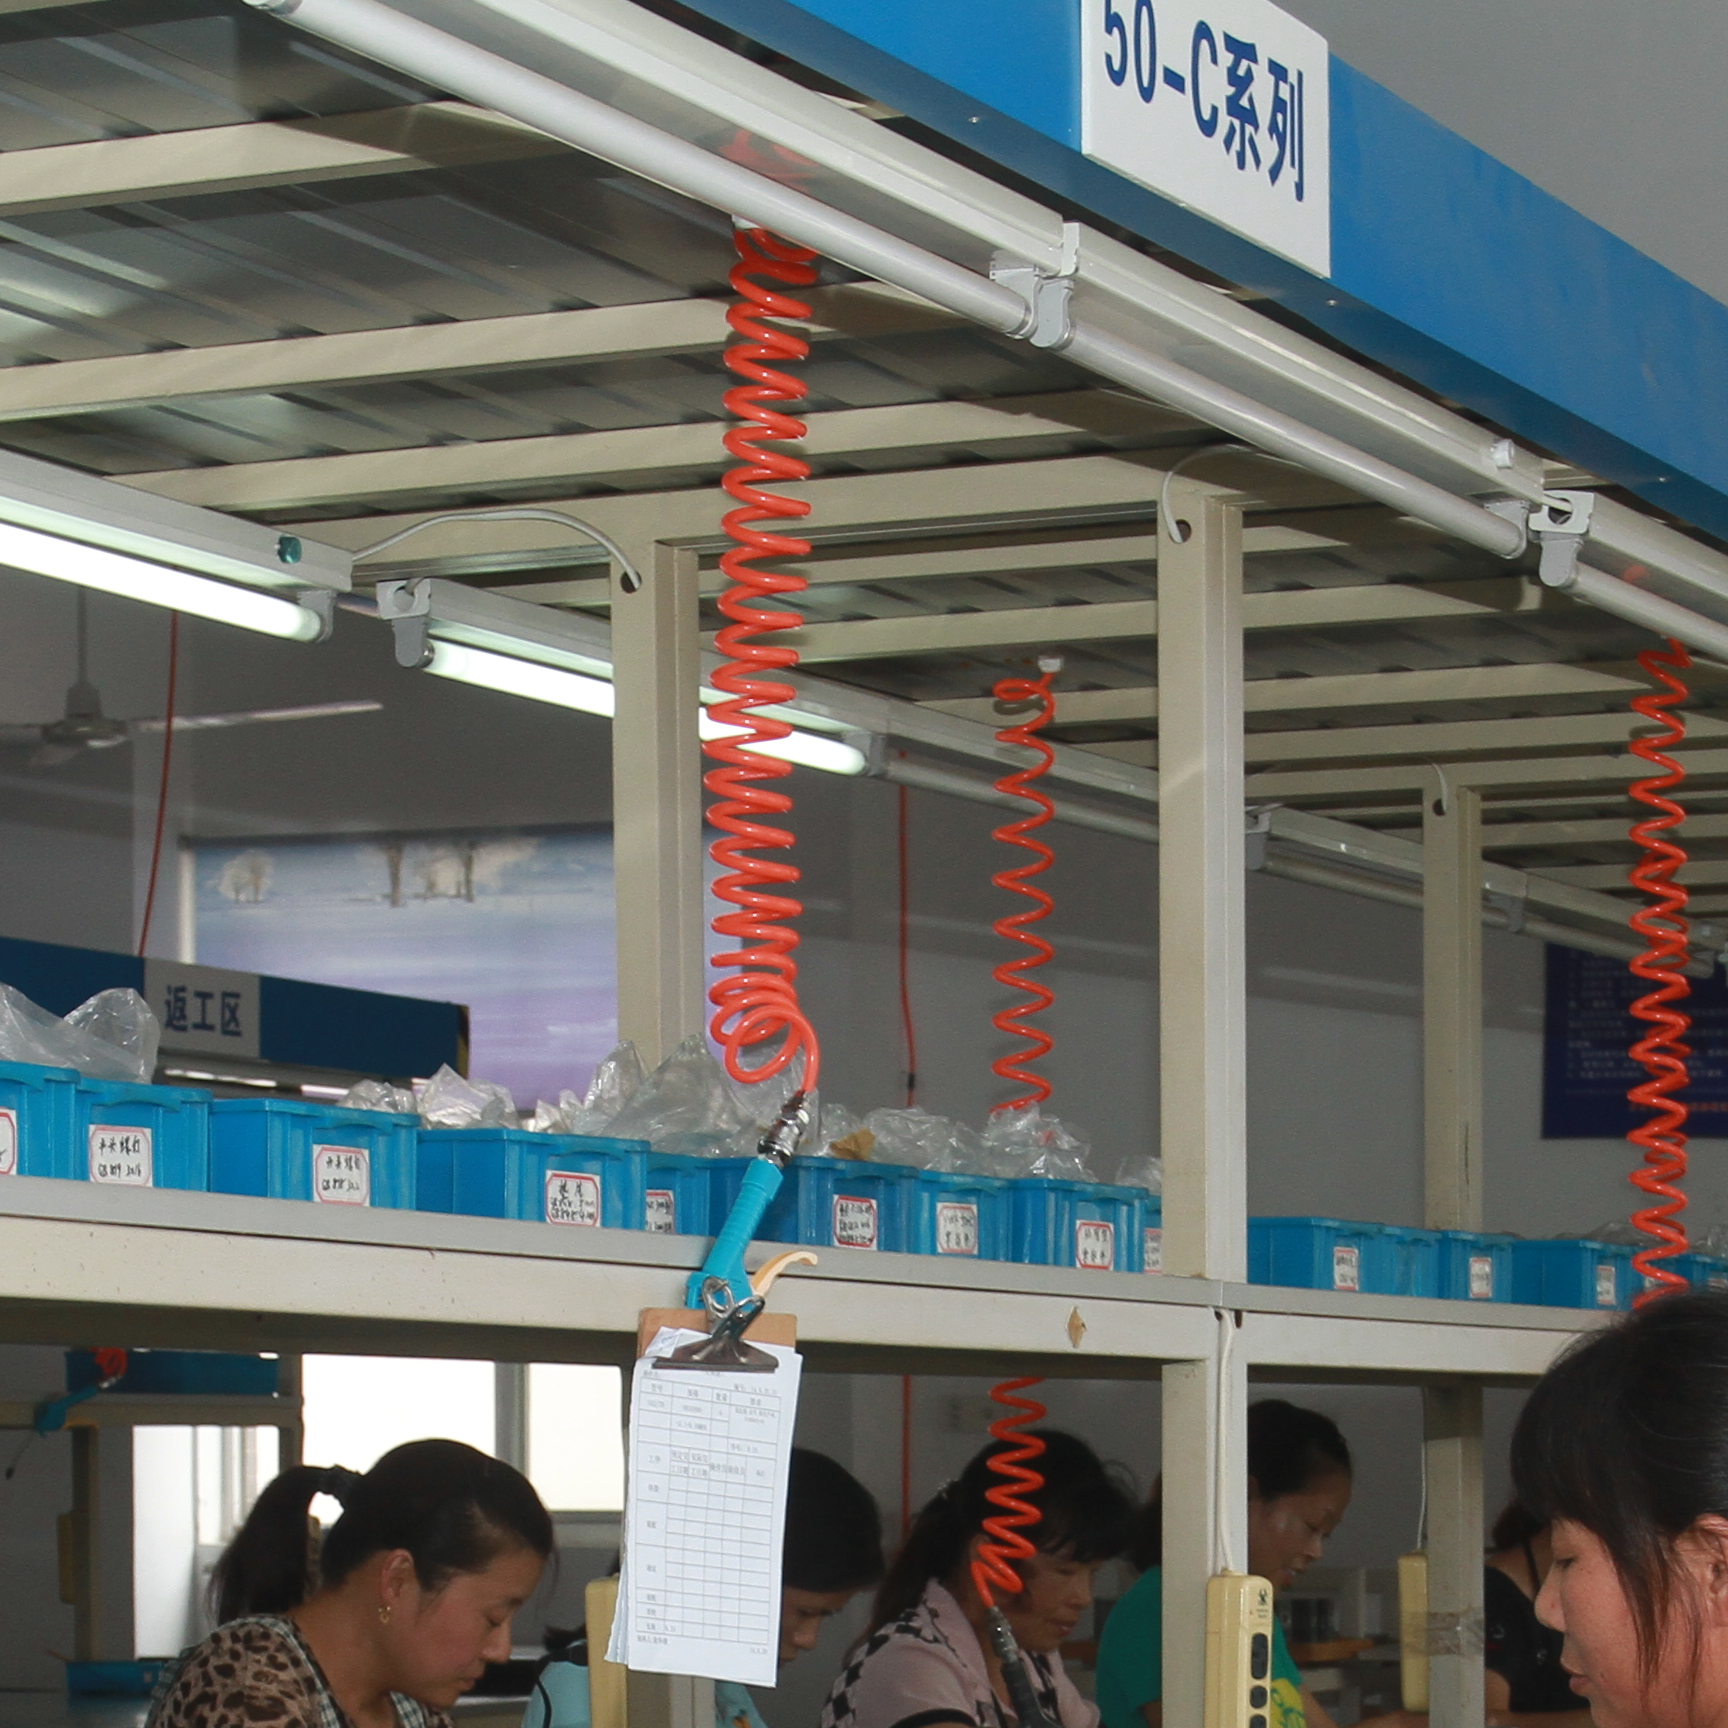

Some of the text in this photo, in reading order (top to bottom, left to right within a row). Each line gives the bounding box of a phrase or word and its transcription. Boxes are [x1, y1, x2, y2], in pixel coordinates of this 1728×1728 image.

[1104, 0, 1305, 202] 50-C系列
[163, 984, 243, 1038] 返工区
